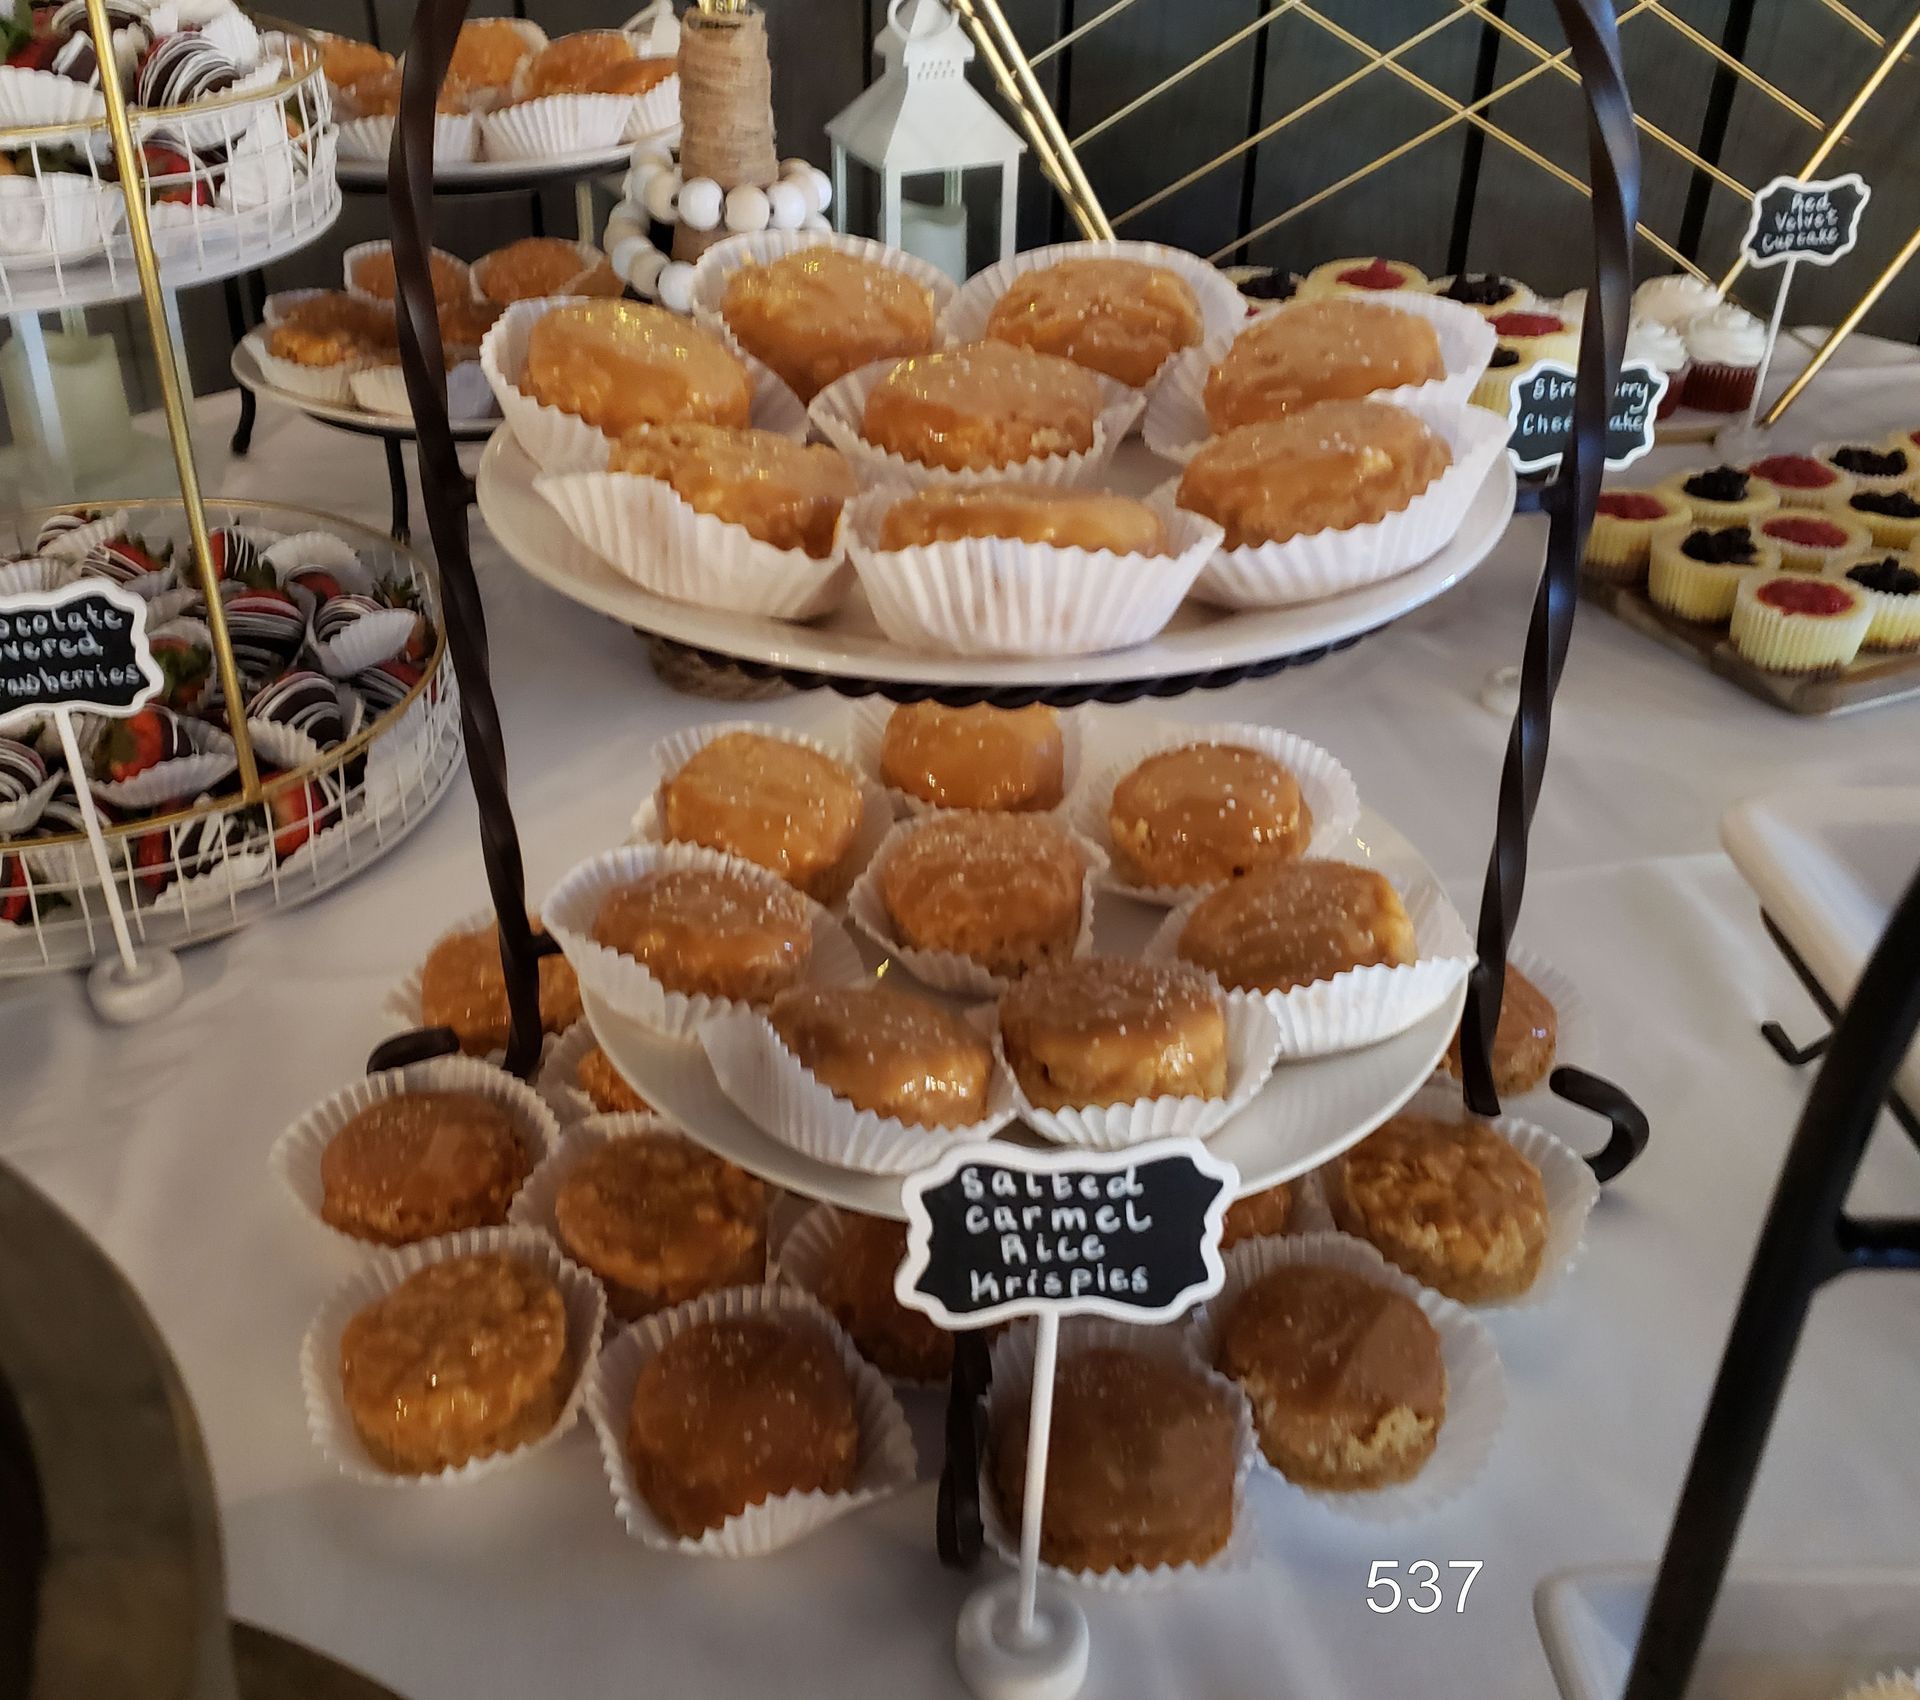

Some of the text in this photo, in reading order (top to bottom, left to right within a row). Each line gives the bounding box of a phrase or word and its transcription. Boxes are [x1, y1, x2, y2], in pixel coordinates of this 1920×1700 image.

[1775, 207, 1838, 232] Velvet
[1532, 376, 1649, 415] Strrry
[1522, 410, 1643, 436] Cheeake
[0, 630, 103, 661] vered
